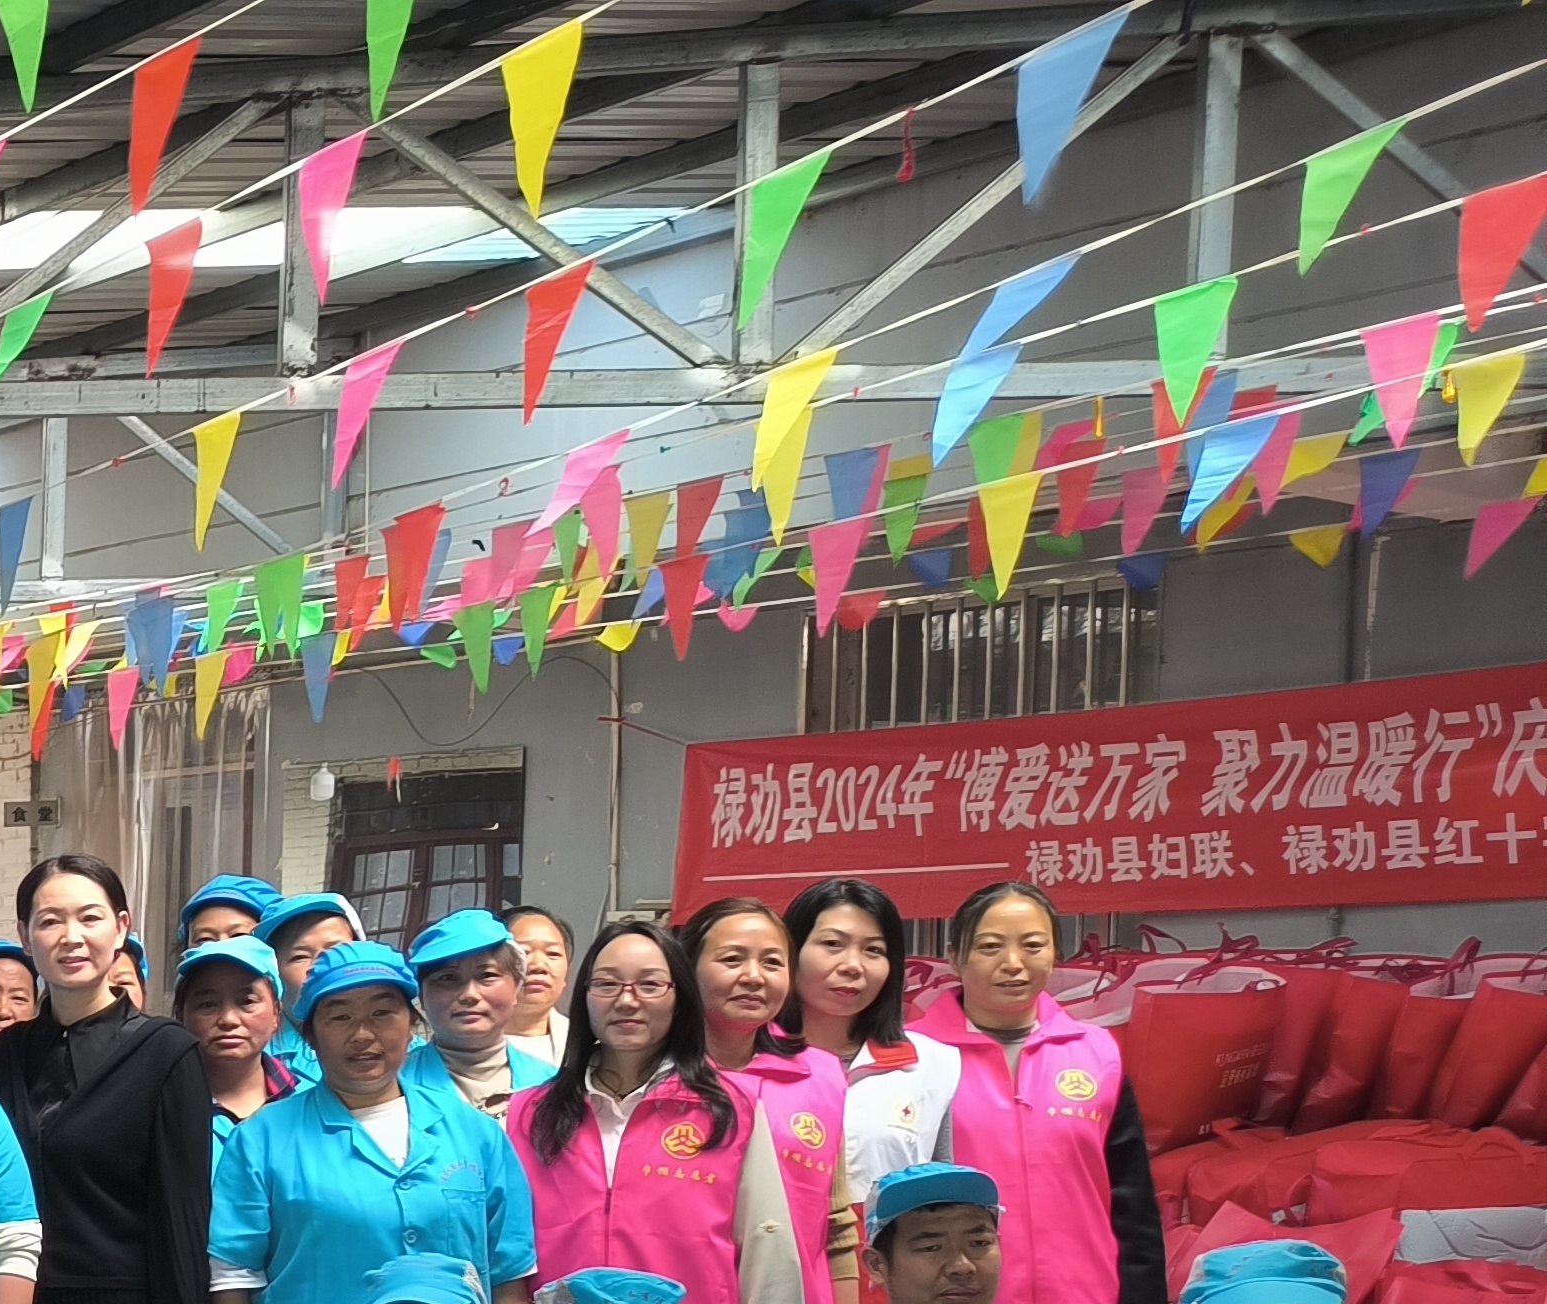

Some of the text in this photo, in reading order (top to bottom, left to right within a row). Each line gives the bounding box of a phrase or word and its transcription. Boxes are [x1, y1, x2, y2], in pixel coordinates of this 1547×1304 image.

[12, 805, 54, 822] 食堂
[1026, 812, 1547, 886] 禄劝县妇联、禄劝县红十
